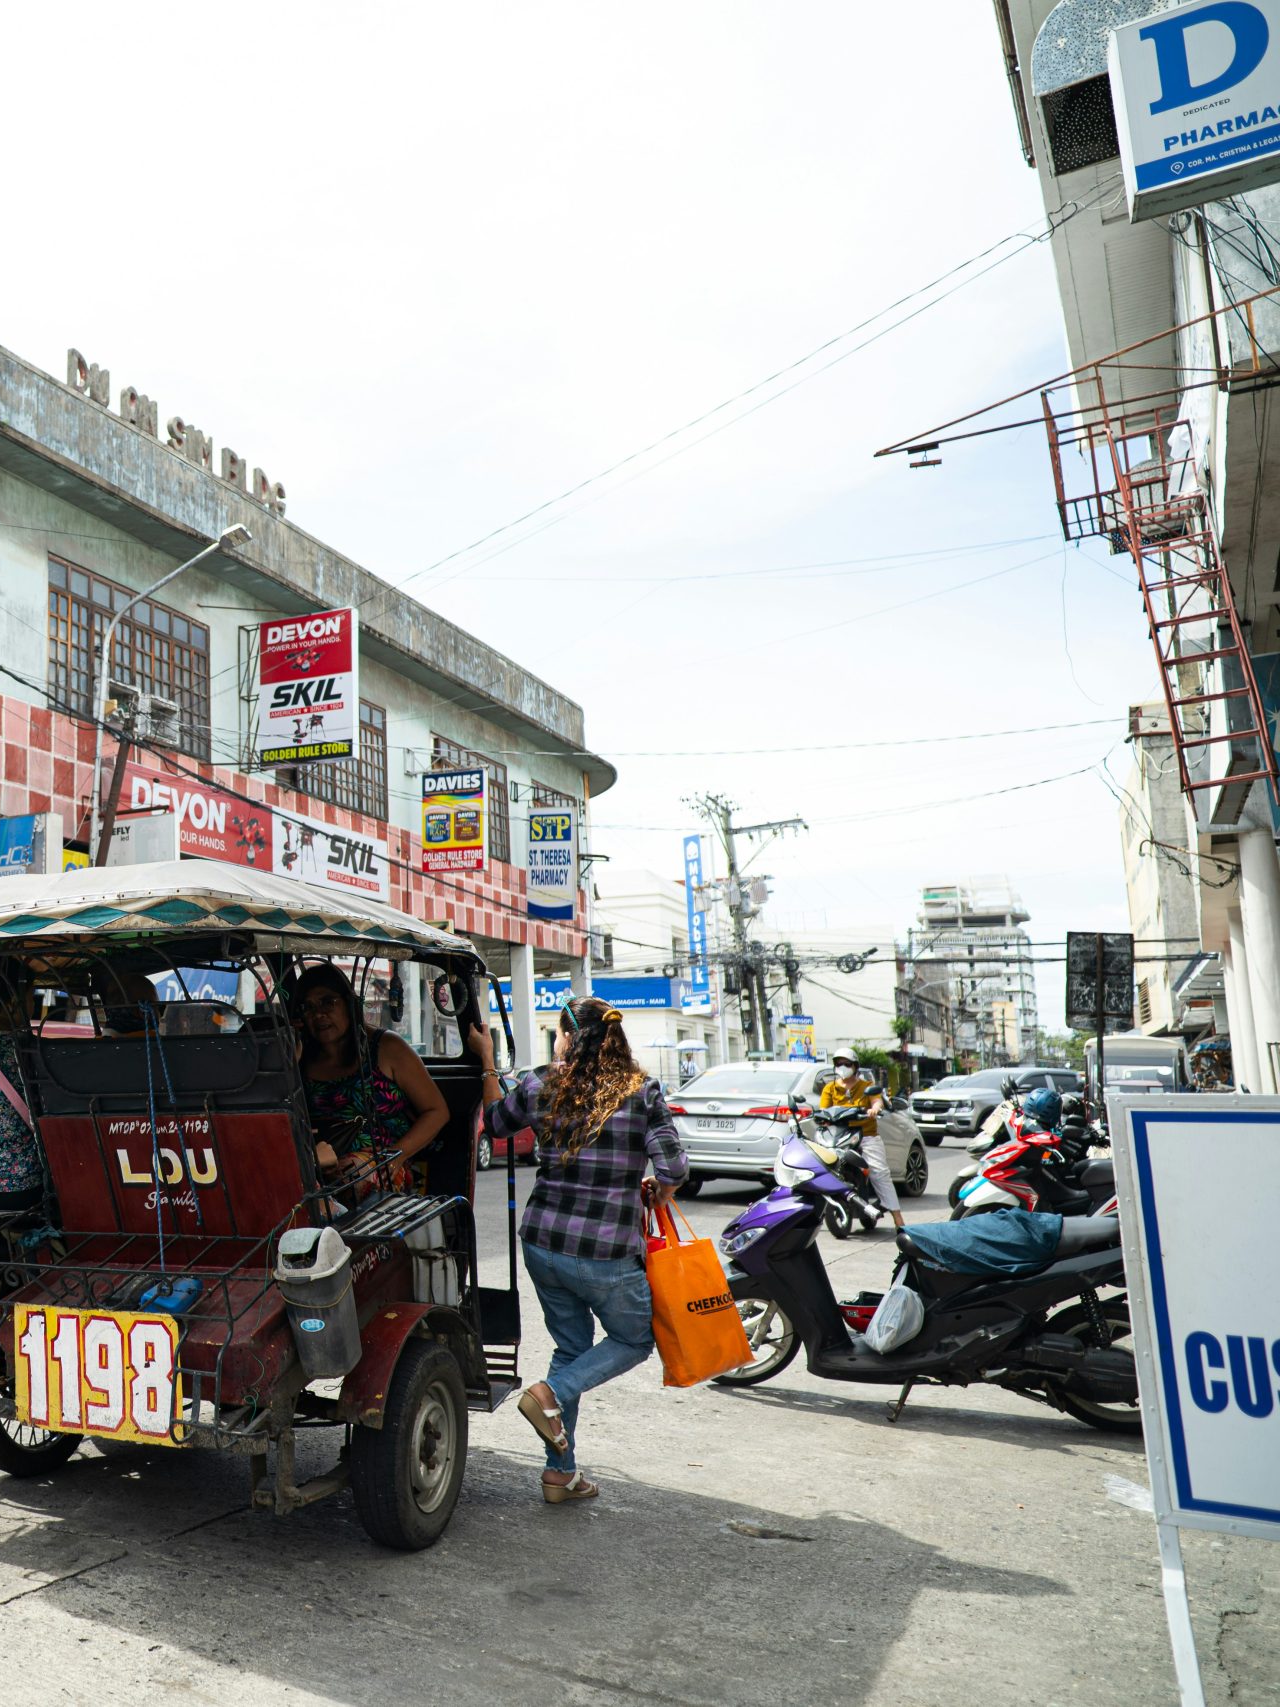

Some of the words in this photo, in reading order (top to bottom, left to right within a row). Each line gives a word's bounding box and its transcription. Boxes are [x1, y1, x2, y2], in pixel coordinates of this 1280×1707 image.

[1139, 1, 1269, 116] D
[1183, 98, 1231, 117] DEDICATED
[1164, 105, 1280, 152] PHARMA
[1188, 158, 1205, 168] COR.
[1206, 154, 1219, 163] MA.
[1219, 145, 1252, 159] CRISTINA
[267, 616, 341, 645] DEVON
[267, 643, 291, 653] POWER
[299, 640, 317, 649] YOUR
[270, 677, 342, 709] SKIL
[270, 708, 302, 718] AMERICAN
[310, 705, 328, 713] SINCE
[263, 748, 297, 762] GOLDEN
[298, 745, 320, 758] RULE
[321, 742, 349, 755] STORE
[424, 773, 481, 792] DAVIES
[131, 776, 227, 834] DEVON
[457, 811, 476, 819] DAVIES
[180, 830, 198, 845] OUR
[531, 815, 570, 841] STP
[327, 834, 379, 876] SKIL
[423, 851, 447, 863] GOLDEN
[447, 850, 463, 860] RULE
[464, 848, 483, 859] STORE
[428, 860, 450, 870] GENERAL
[451, 858, 477, 869] HARDWARE
[529, 850, 539, 866] ST.
[540, 850, 571, 866] THERESA
[328, 871, 352, 885] AMERICAN
[356, 878, 370, 890] SINCE
[531, 869, 568, 886] PHARMACY
[608, 998, 646, 1009] DUMAGUETE
[650, 997, 666, 1005] MAIN
[116, 1148, 218, 1185] LOU
[20, 1311, 174, 1438] 1198
[1184, 1331, 1280, 1418] CU
